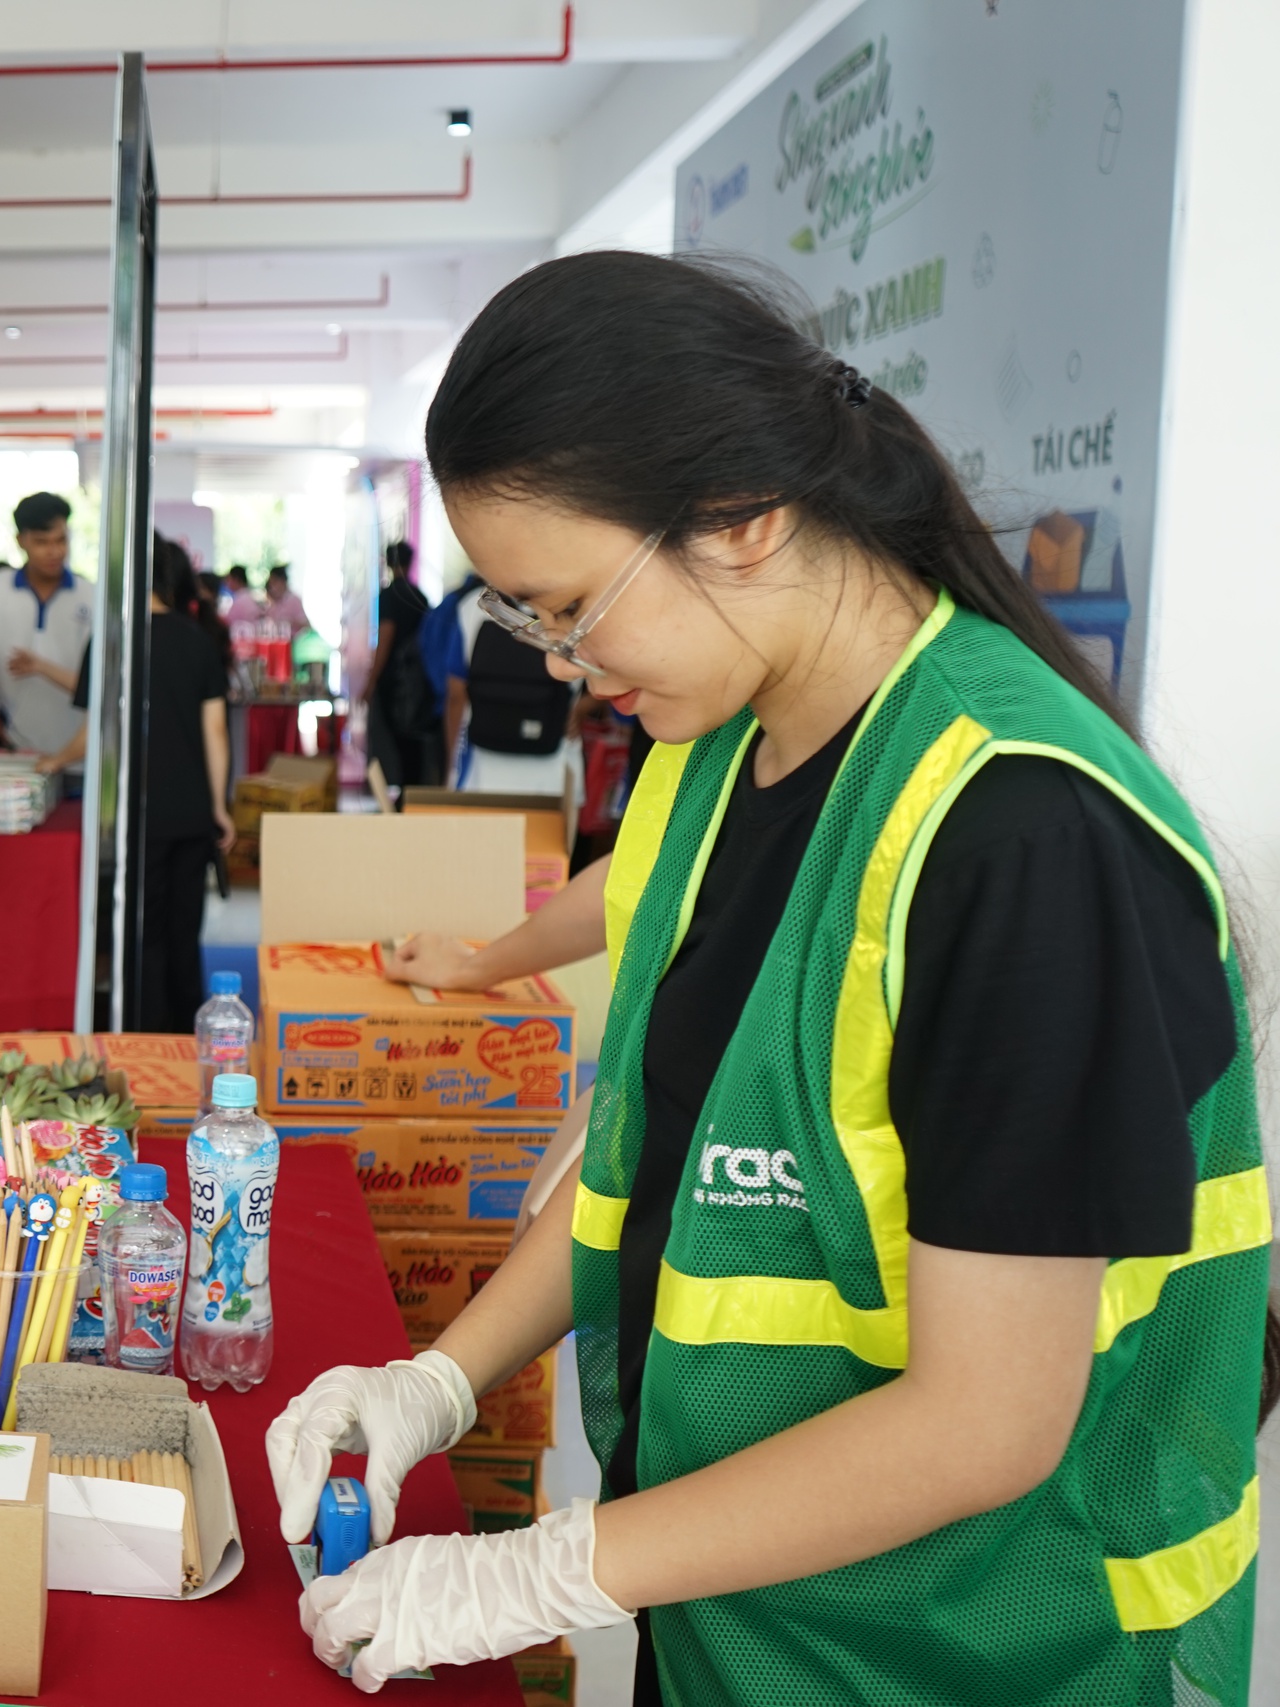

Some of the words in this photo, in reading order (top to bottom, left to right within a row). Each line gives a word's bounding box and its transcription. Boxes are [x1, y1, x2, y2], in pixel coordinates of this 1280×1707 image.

[863, 254, 946, 345] XANH
[1032, 424, 1063, 476] TÁI
[1069, 407, 1117, 471] CHẾ
[409, 1154, 463, 1190] Hảo
[406, 1256, 454, 1287] Hảo
